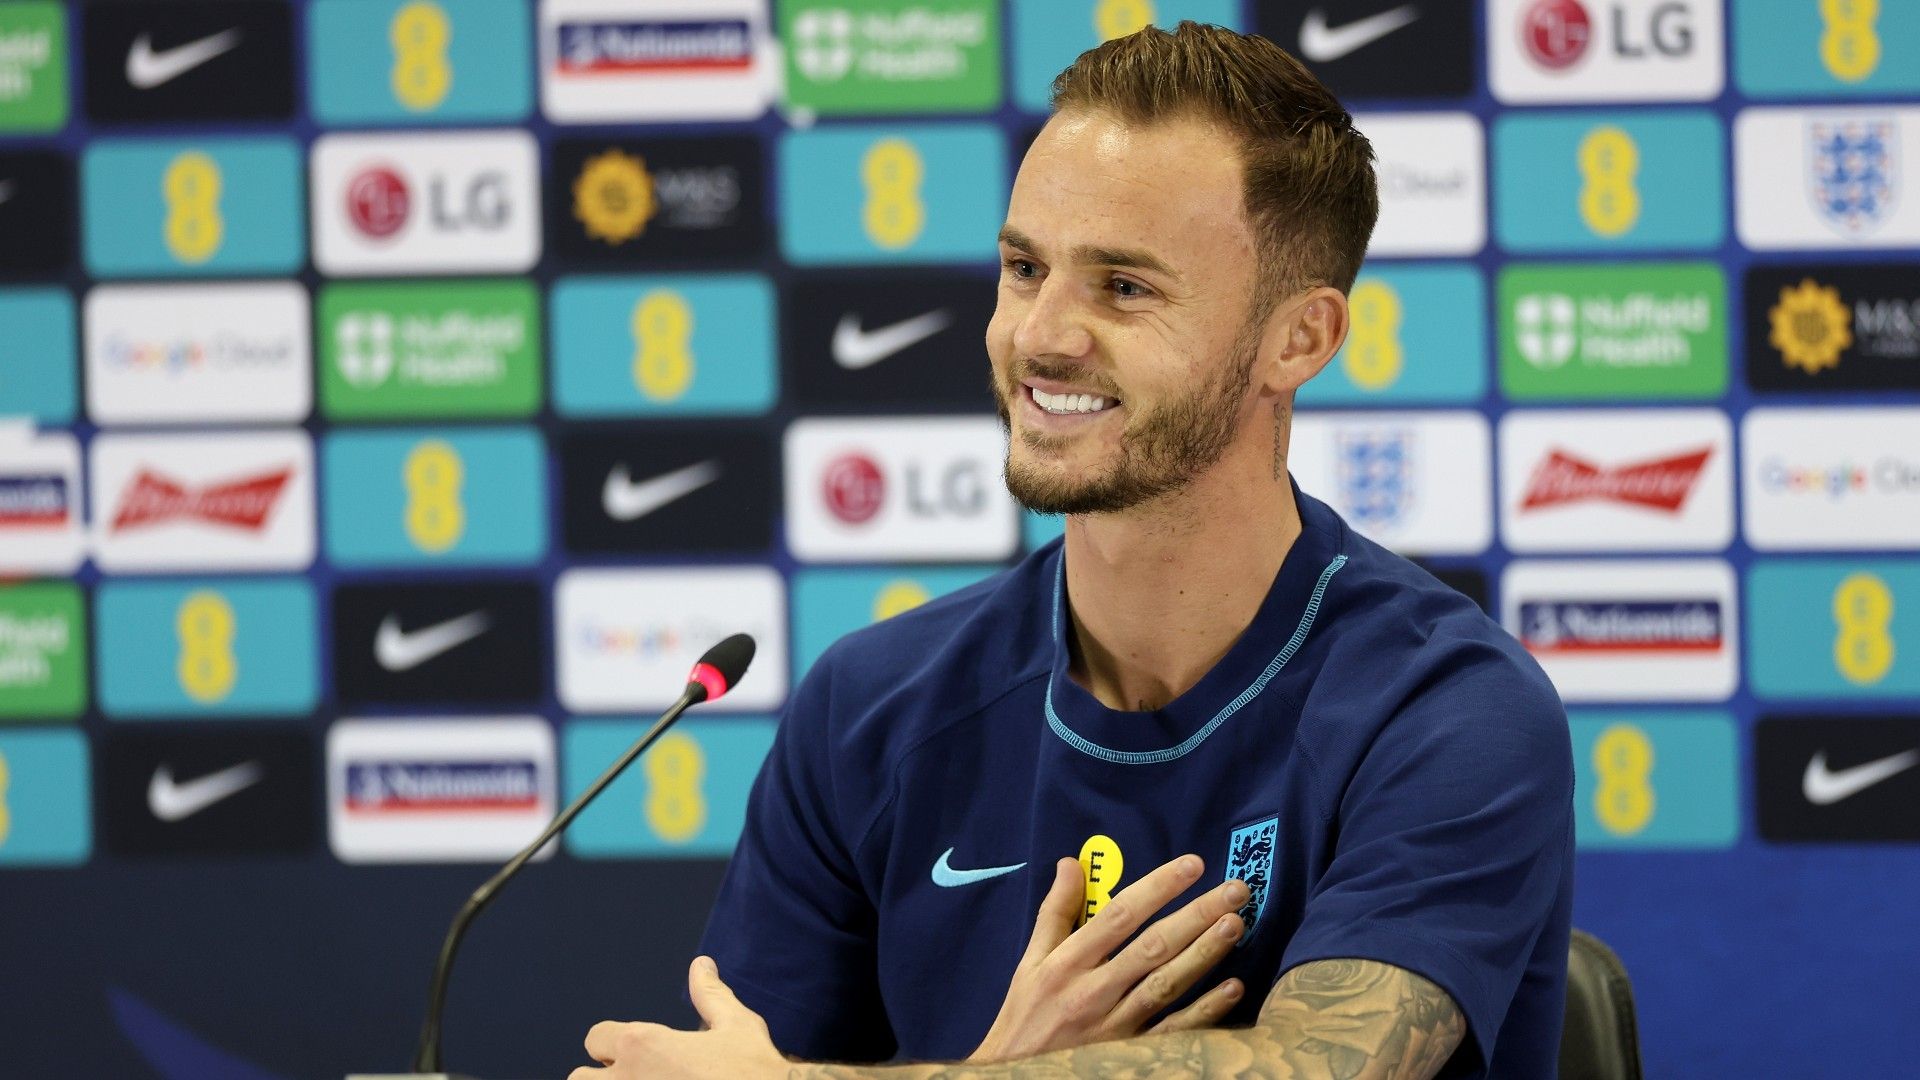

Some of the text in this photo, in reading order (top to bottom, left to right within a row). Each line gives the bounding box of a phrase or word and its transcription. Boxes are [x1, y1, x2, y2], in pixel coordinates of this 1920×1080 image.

[1612, 3, 1694, 58] LG
[429, 171, 512, 232] LG
[904, 458, 988, 518] LG
